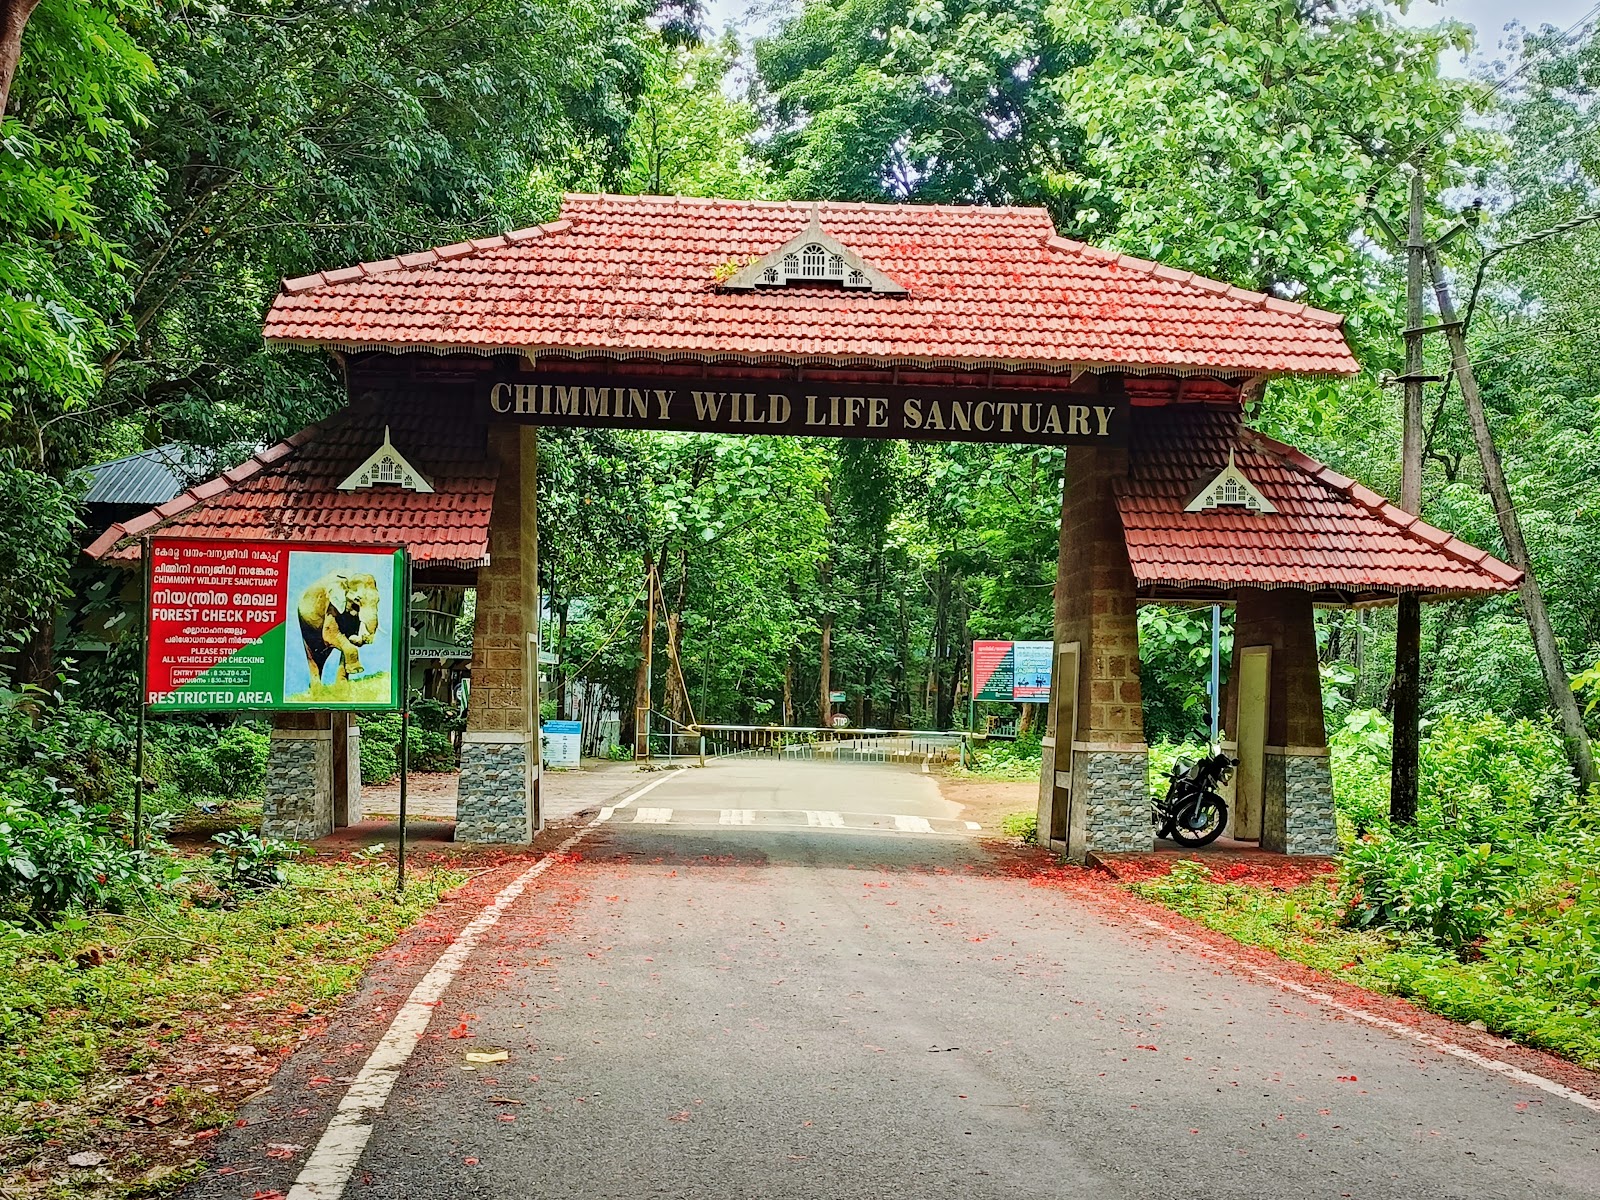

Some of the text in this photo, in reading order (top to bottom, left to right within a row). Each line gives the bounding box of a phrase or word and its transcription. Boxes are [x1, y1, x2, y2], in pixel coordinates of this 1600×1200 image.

[490, 382, 1115, 436] CHIMMINY WILD LIFE SANCTUARY
[154, 547, 180, 560] കേരള
[251, 550, 281, 563] വകുപ്പ്
[154, 562, 191, 574] ചിമ്മിനി
[238, 567, 279, 577] സങ്കേതം
[153, 575, 278, 587] CHIMMONY WILDLIFE SANCTUARY
[153, 589, 278, 607] നിയന്ത്രിത മേഖല
[152, 608, 277, 623] FOREST CHECK POST
[191, 647, 238, 656] PLEASE STOP
[161, 655, 265, 664] ALL VEHICLES FOR CHECKING
[173, 669, 194, 677] ENTRY
[148, 691, 274, 704] RESTRICTED AREA
[832, 717, 848, 726] STOP
